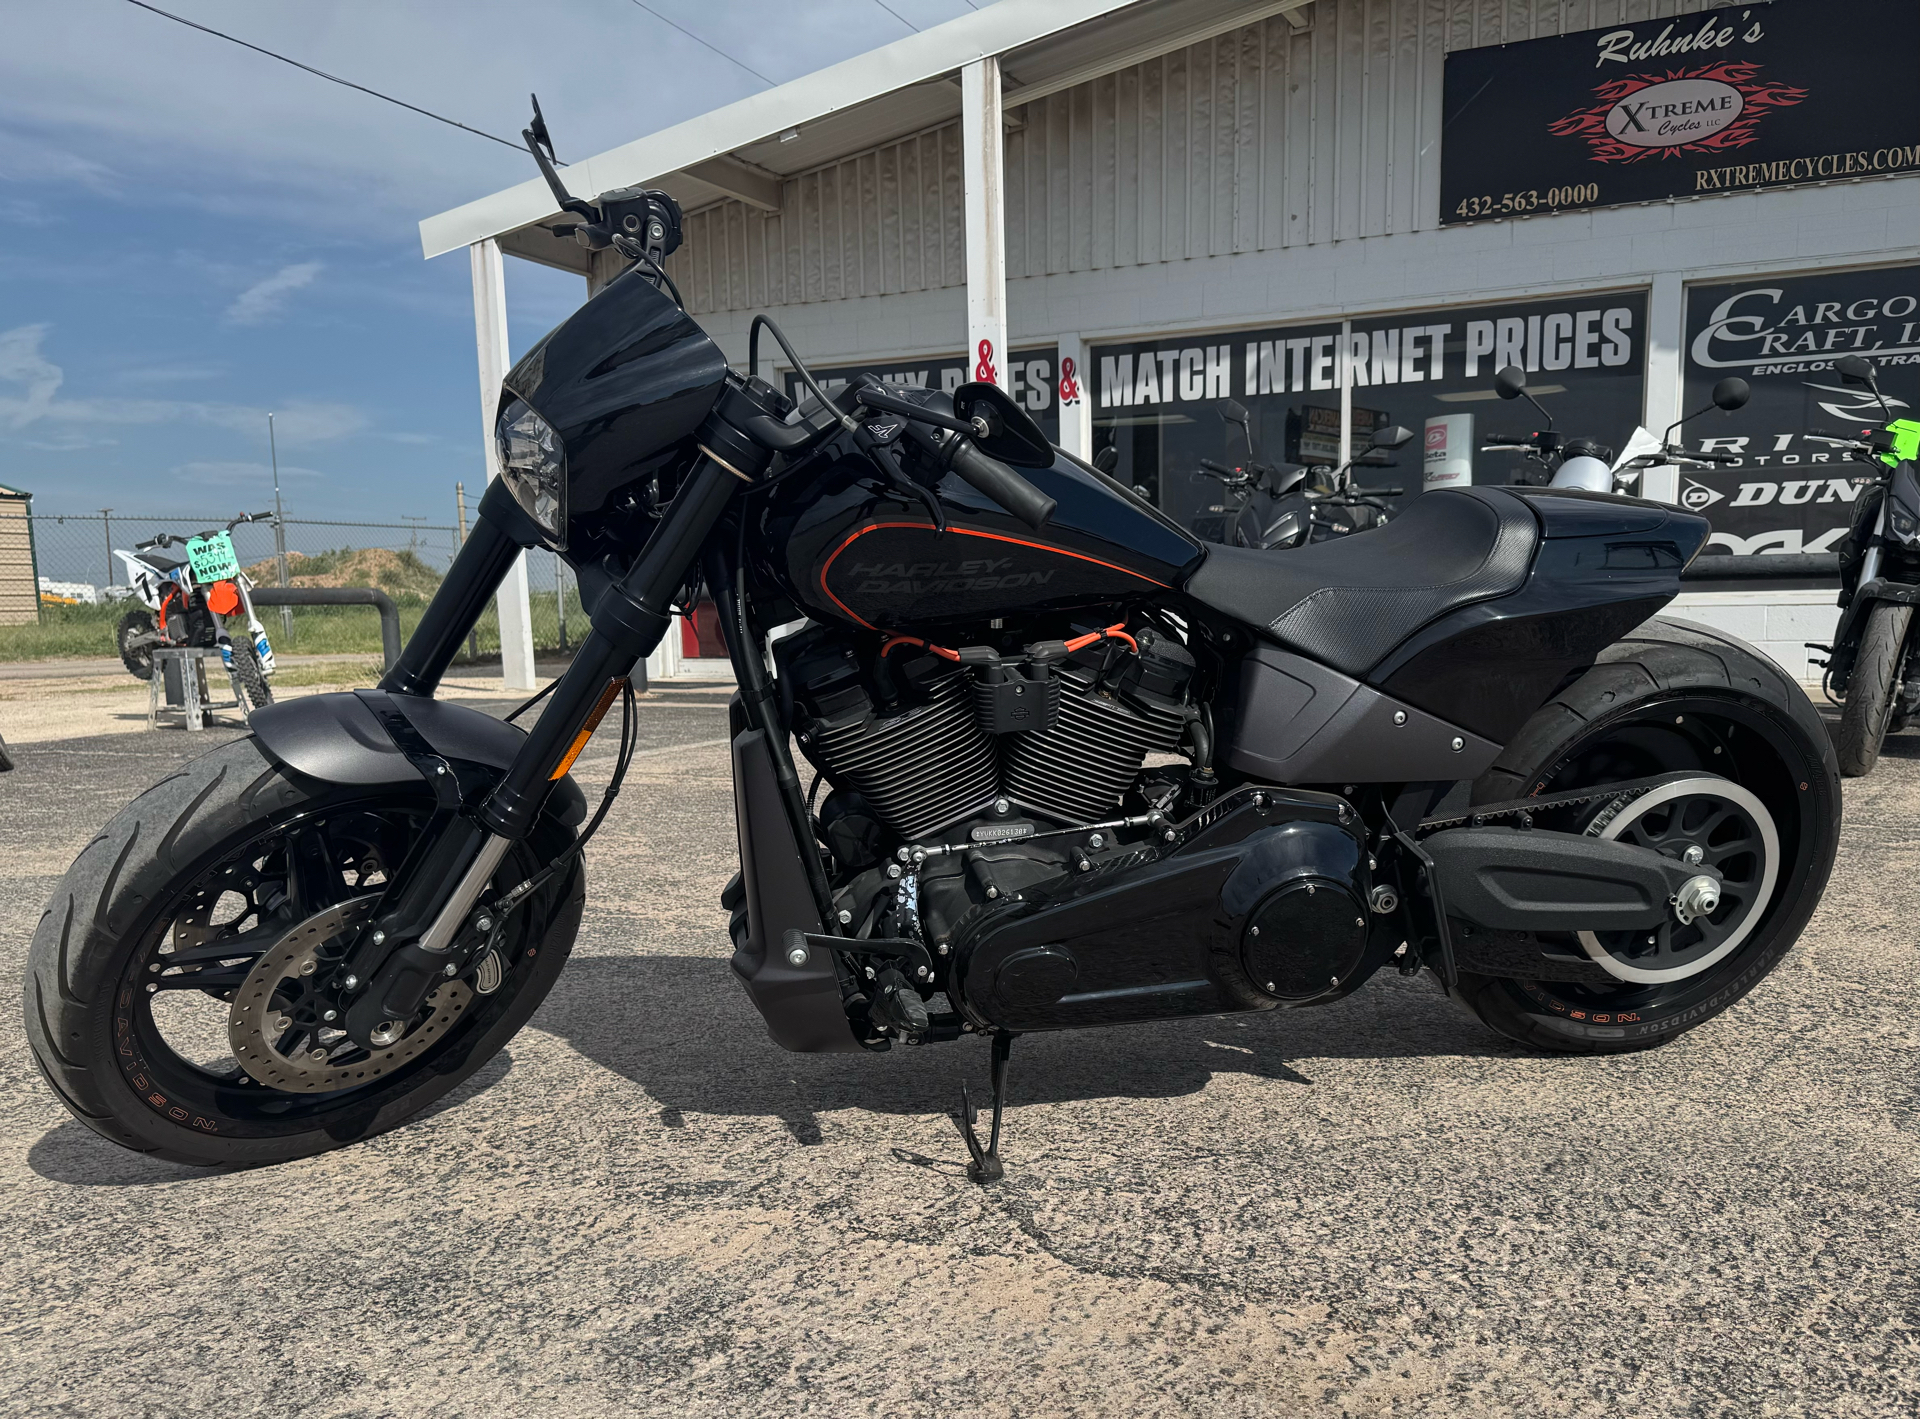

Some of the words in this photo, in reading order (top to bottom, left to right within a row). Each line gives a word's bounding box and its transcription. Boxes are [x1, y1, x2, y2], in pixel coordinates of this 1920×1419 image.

[1595, 11, 1764, 68] Ruhnke's
[1657, 120, 1702, 136] Cycles
[1706, 119, 1721, 127] LLC
[1695, 145, 1920, 191] RXTREMECYCLES.COM
[1456, 182, 1599, 217] 432-563-0000
[1709, 288, 1917, 341] CARGO
[1100, 344, 1231, 408] MATCH
[1245, 323, 1451, 396] INTERNET
[1465, 307, 1633, 377] PRICES
[193, 542, 226, 555] WAS
[199, 562, 231, 577] NOW
